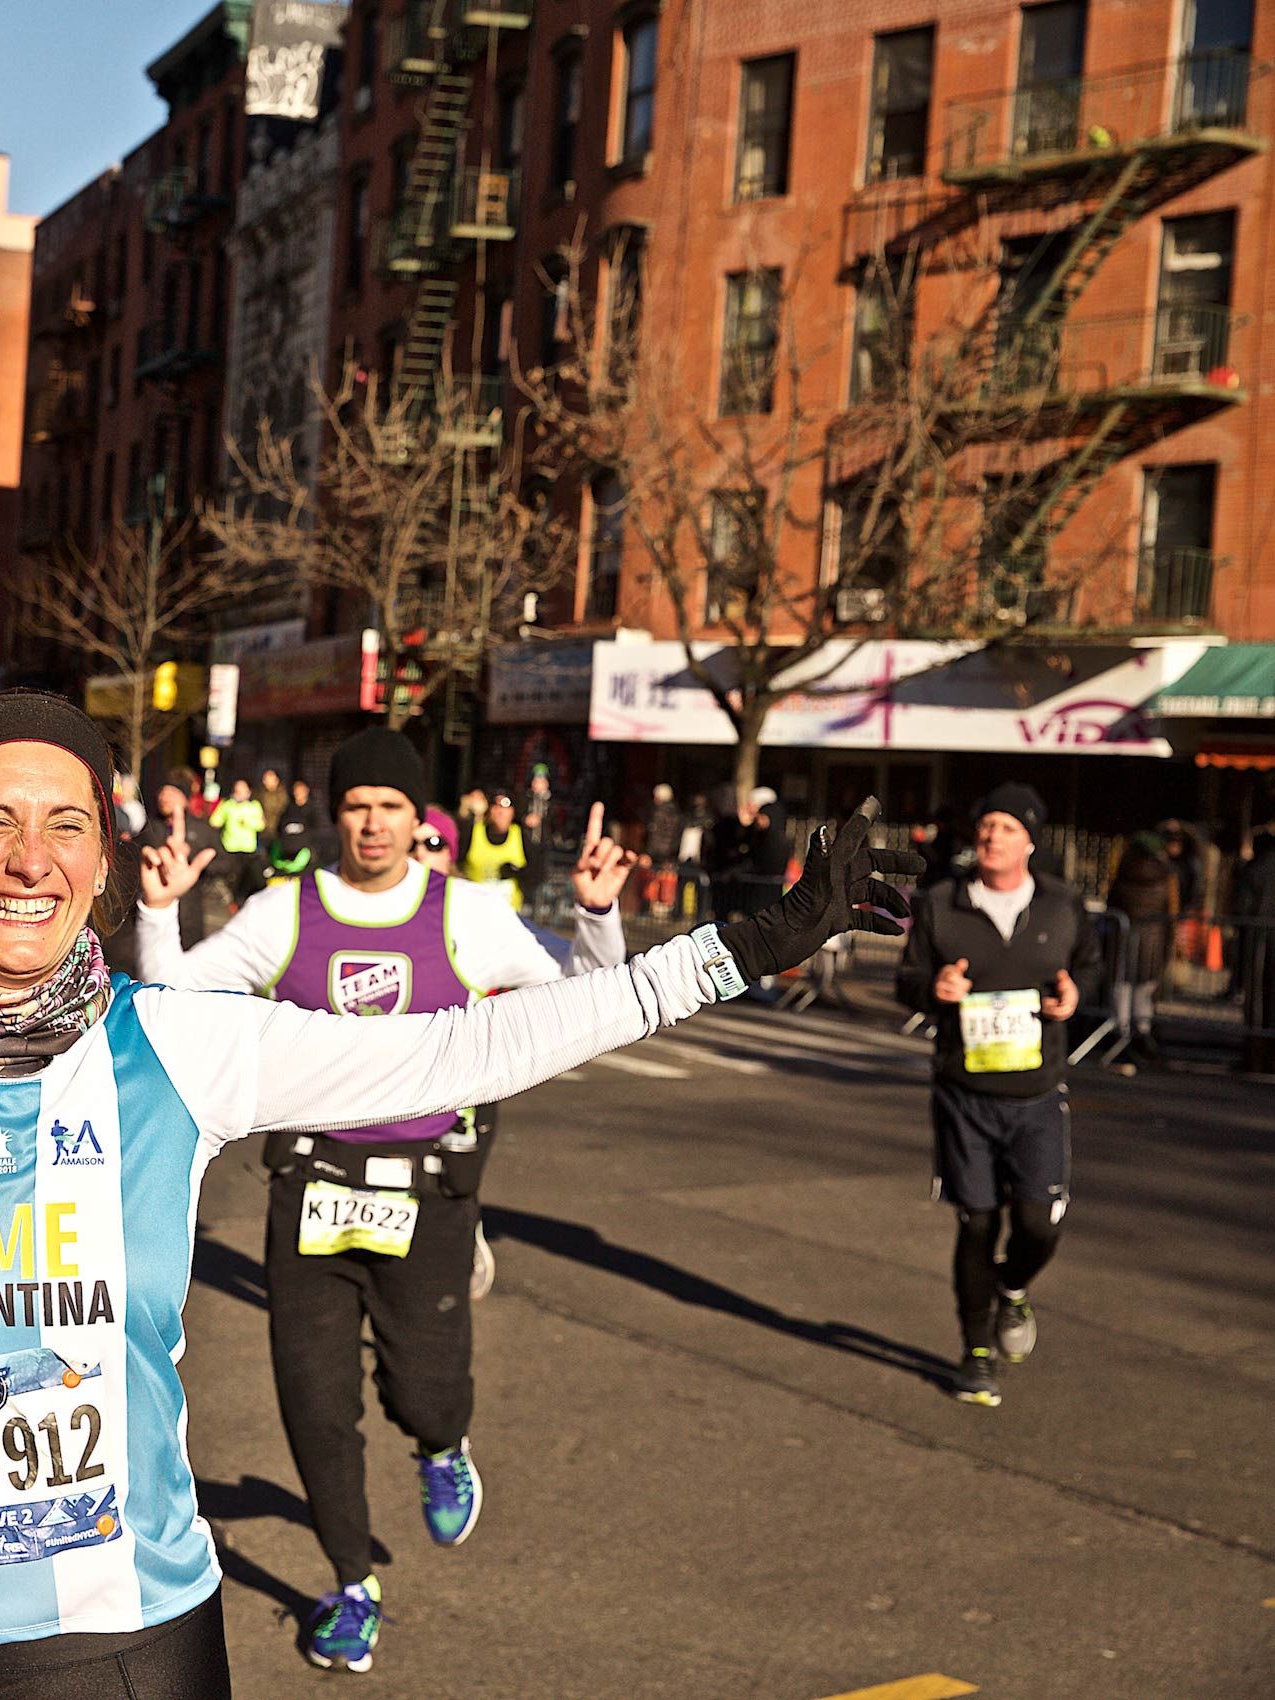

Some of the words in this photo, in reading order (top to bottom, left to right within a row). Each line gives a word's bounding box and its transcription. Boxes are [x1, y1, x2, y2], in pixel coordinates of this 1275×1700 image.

[341, 964, 398, 996] TEAM
[60, 1157, 105, 1166] AMAISON
[22, 1508, 33, 1525] 2
